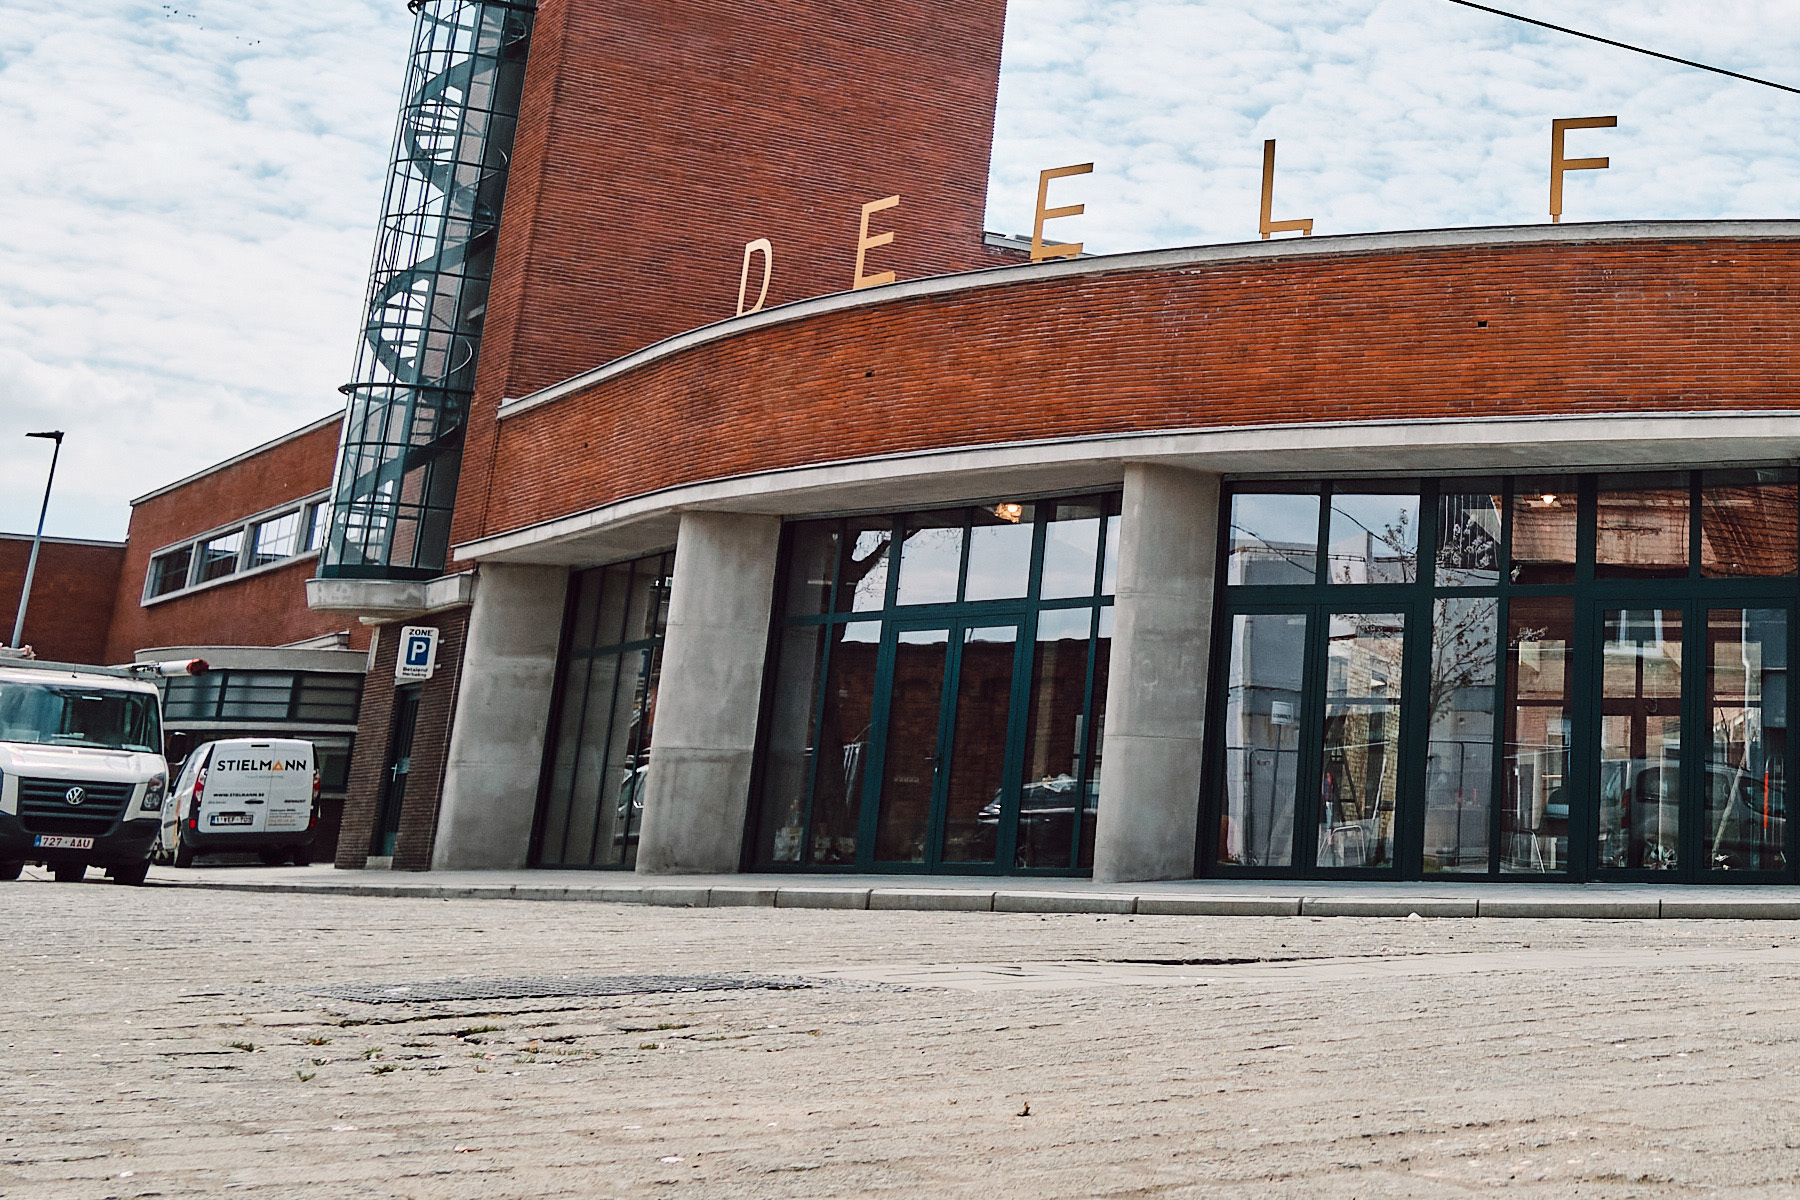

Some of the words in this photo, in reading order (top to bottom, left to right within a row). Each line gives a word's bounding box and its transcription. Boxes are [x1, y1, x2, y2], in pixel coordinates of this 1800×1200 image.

[409, 628, 434, 636] ZONE
[411, 641, 427, 661] P
[217, 760, 307, 771] STIELMANN
